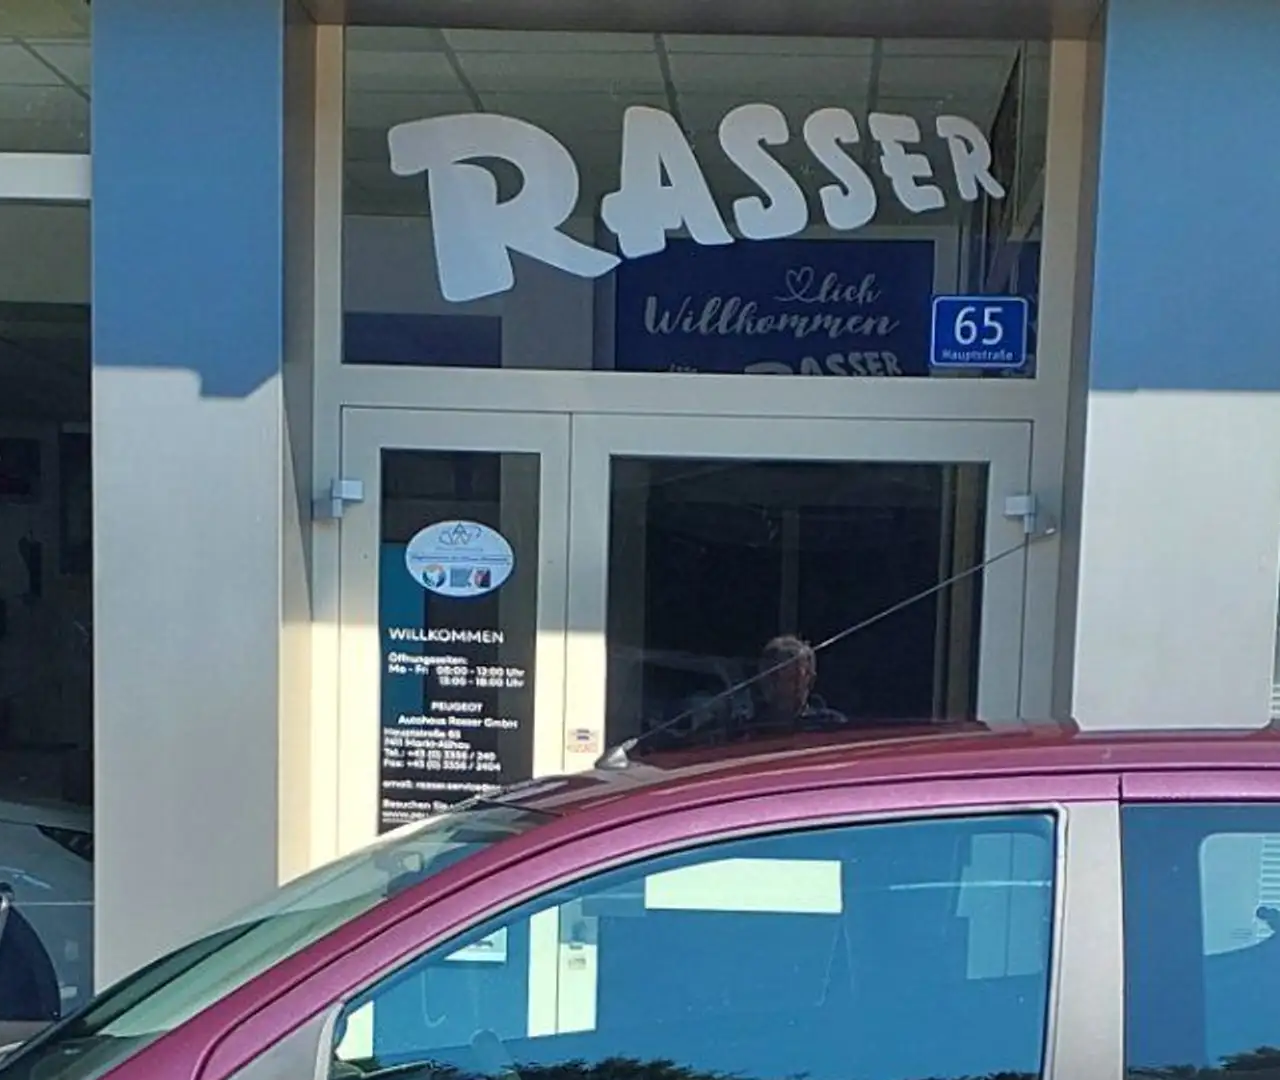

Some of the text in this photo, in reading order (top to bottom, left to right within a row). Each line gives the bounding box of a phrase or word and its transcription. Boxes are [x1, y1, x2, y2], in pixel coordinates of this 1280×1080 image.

[389, 104, 1005, 302] RASSER
[644, 296, 901, 338] Willkommen
[954, 306, 1004, 346] 65
[745, 352, 904, 377] ASSER
[388, 627, 504, 644] WILLKOMMEN
[388, 665, 407, 674] Mo
[431, 702, 483, 712] PEUGEOT
